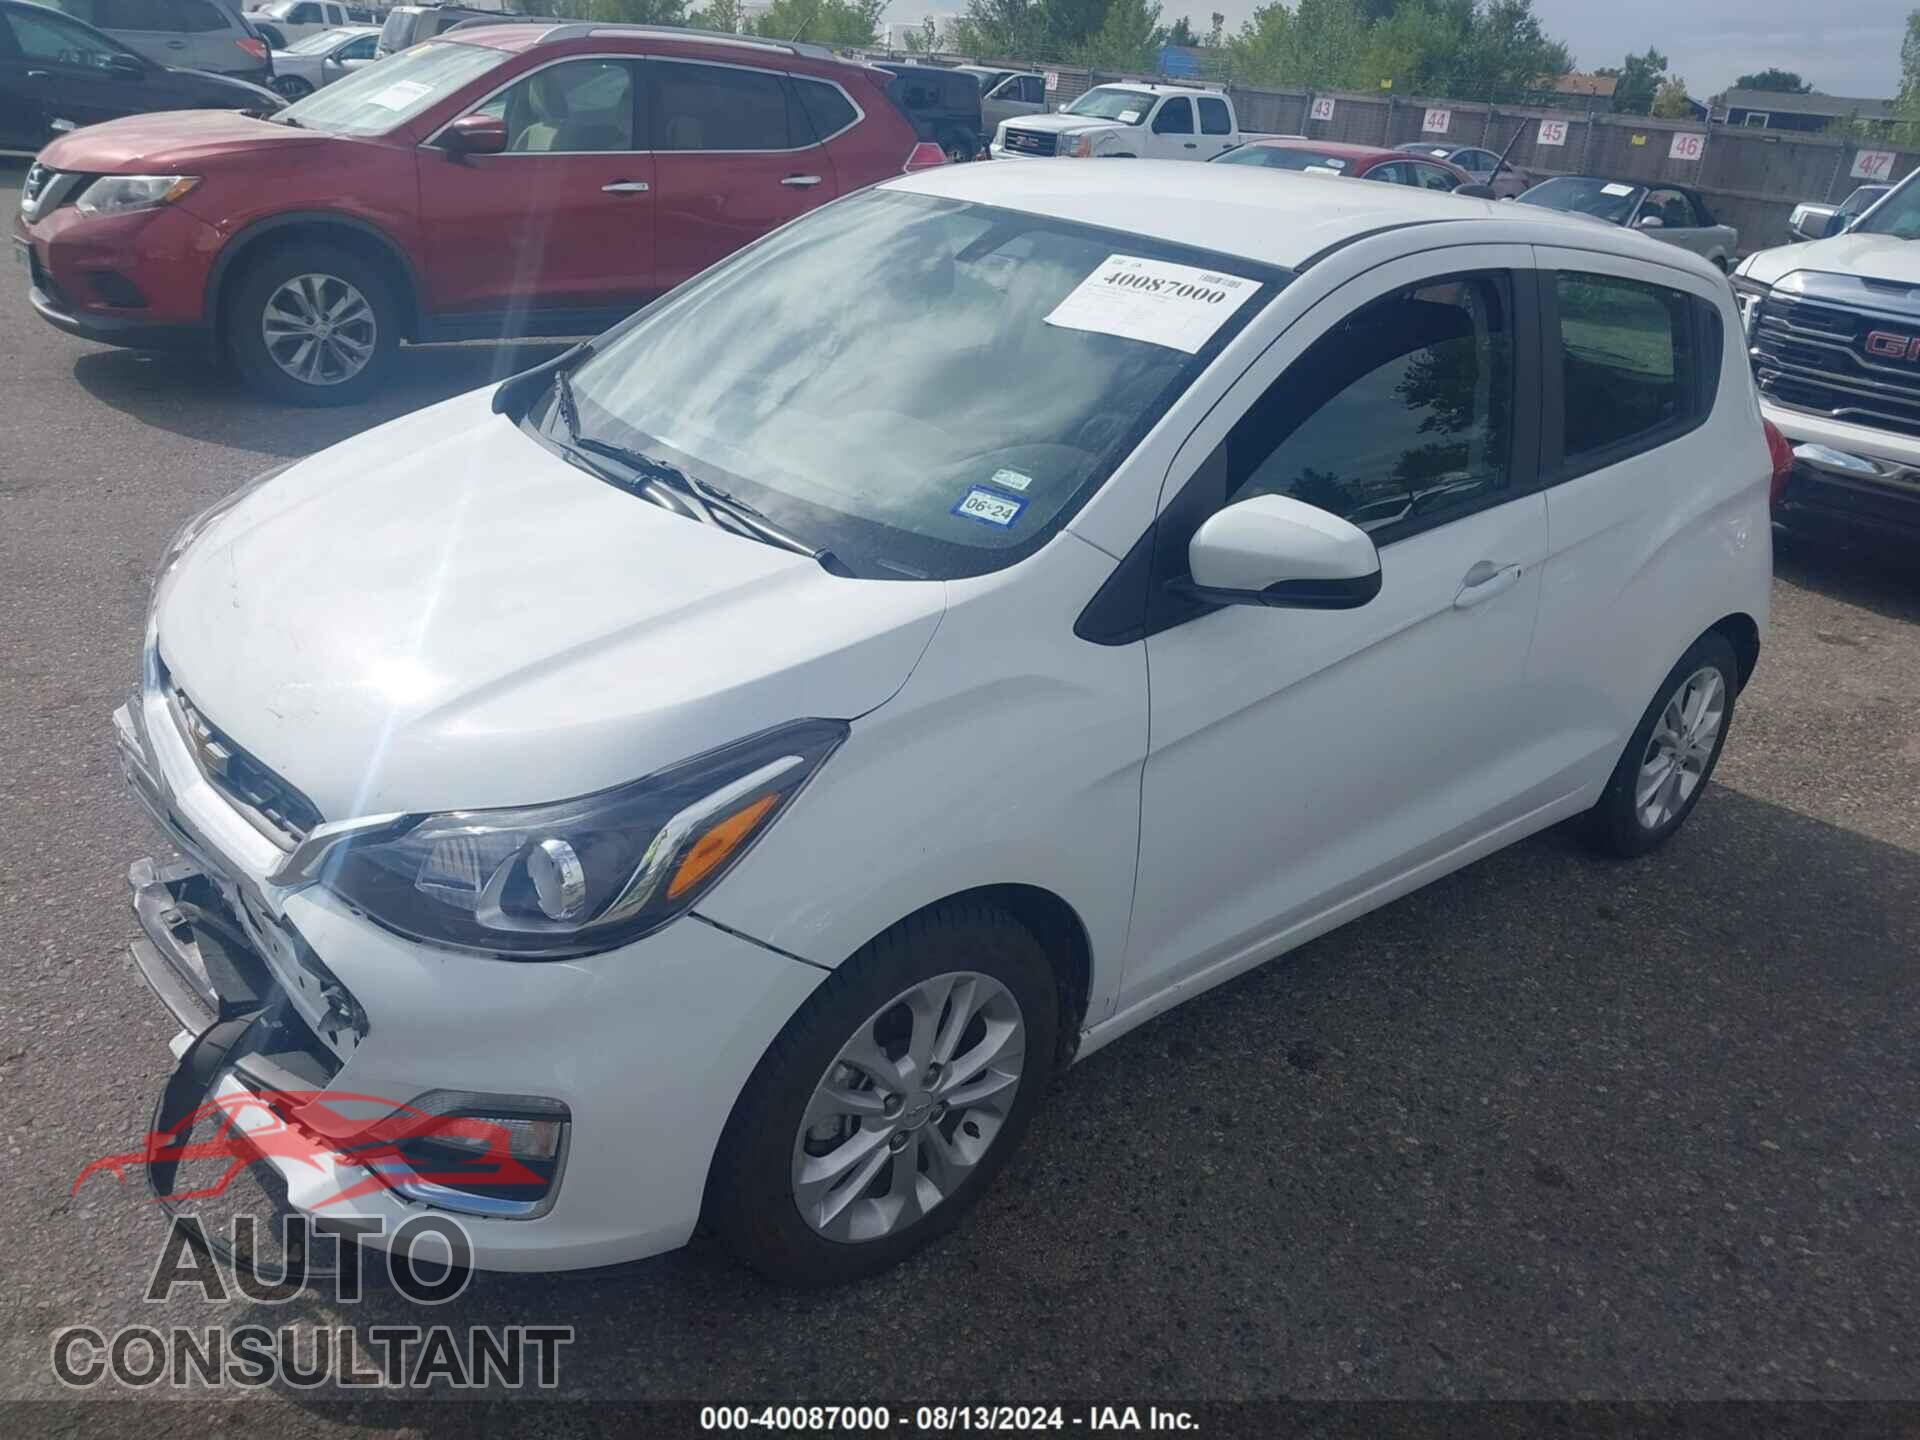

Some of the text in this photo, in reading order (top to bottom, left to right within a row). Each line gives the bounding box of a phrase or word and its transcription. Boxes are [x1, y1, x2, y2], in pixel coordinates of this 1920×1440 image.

[1314, 99, 1331, 117] 43
[1427, 111, 1447, 129] 44
[1542, 125, 1563, 142] 45
[1676, 138, 1698, 156] 46
[1858, 155, 1889, 173] 47
[1103, 271, 1226, 304] 40087000
